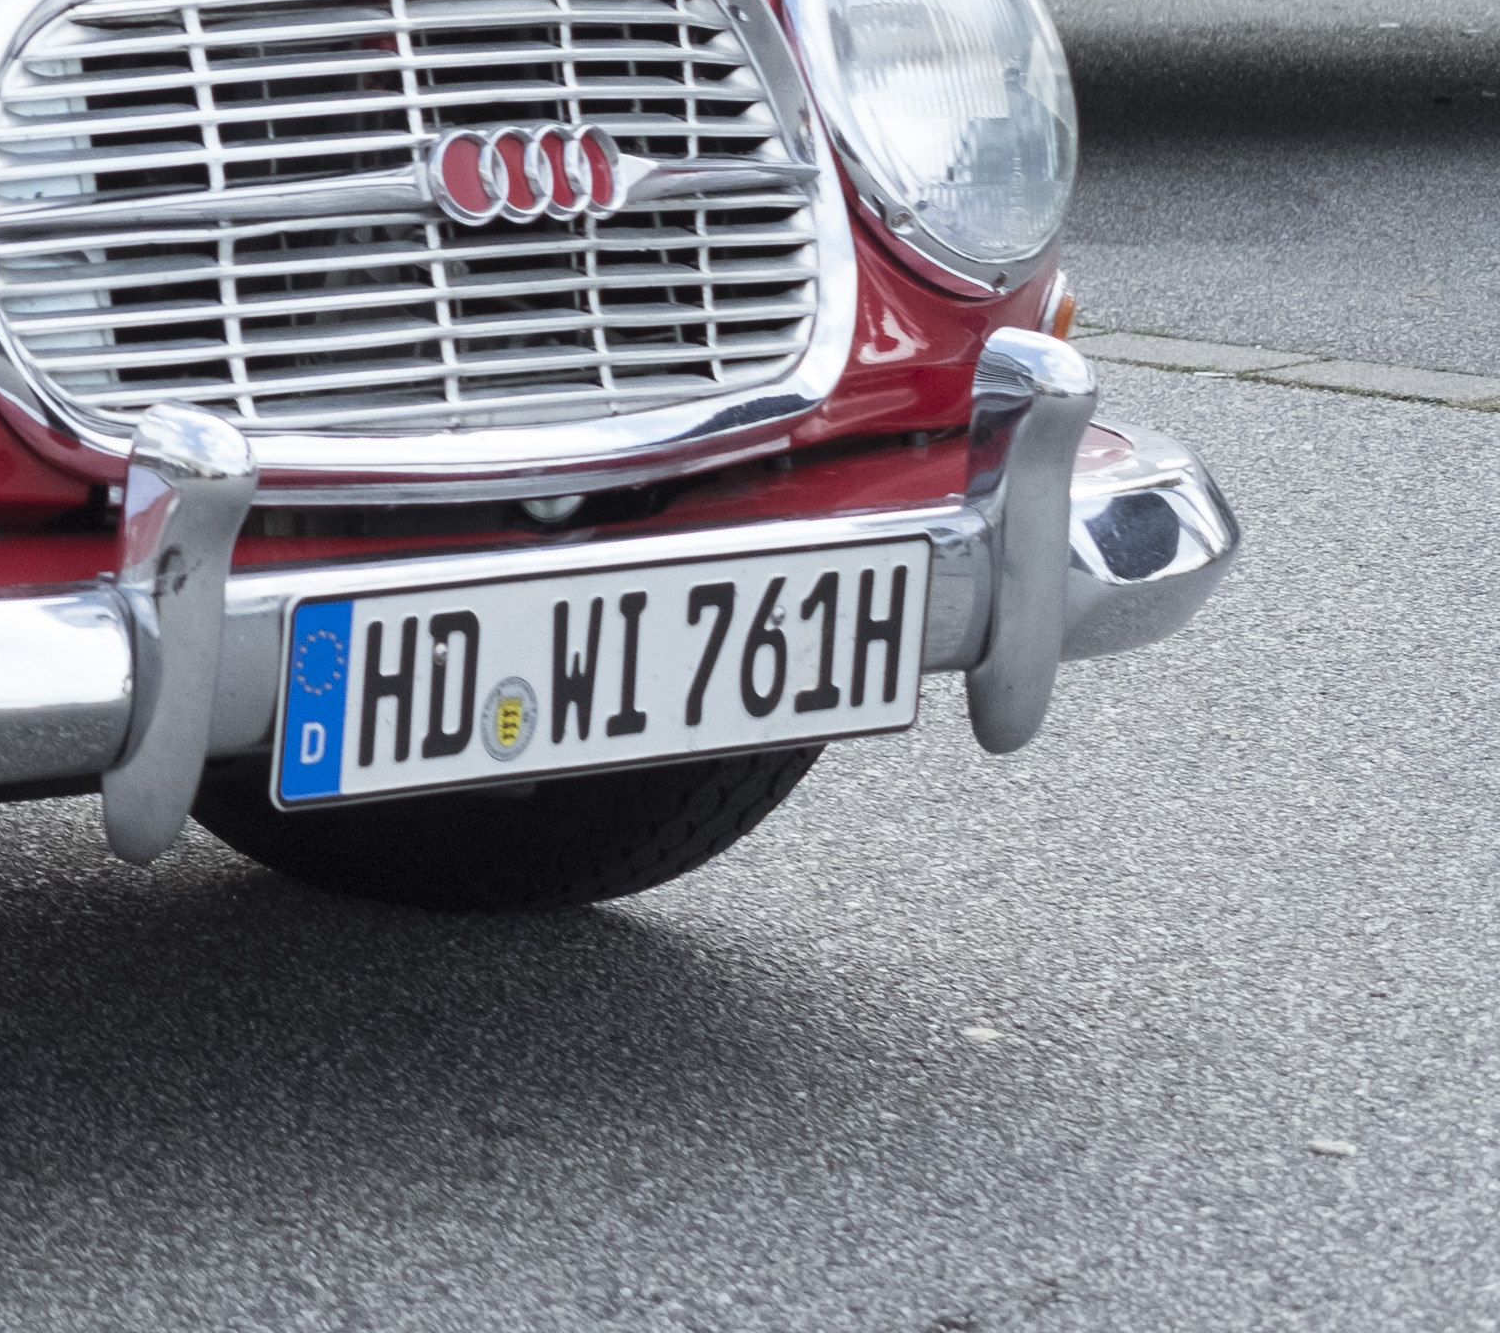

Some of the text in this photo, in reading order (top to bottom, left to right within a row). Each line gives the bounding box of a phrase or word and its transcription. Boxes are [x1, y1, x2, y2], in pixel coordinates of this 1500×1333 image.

[357, 609, 481, 768] HD
[551, 589, 648, 744] WI
[686, 563, 909, 727] 761H
[300, 722, 326, 765] D
